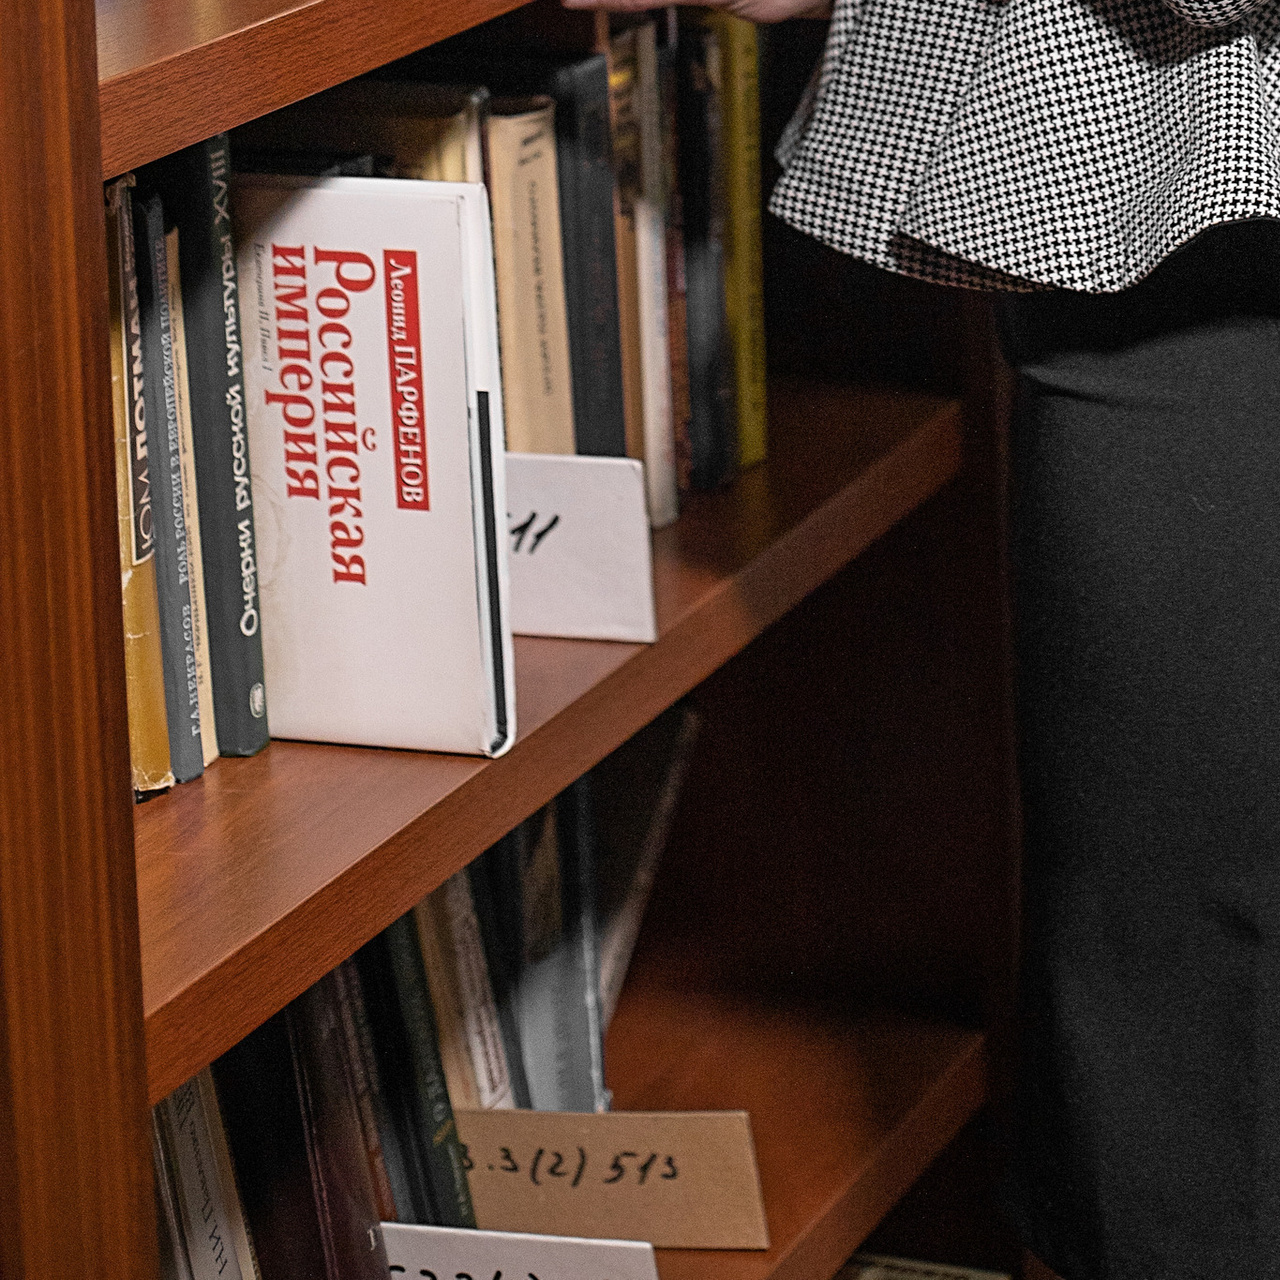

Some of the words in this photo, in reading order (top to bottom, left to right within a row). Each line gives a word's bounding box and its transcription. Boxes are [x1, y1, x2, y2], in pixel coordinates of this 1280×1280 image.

[211, 148, 229, 225] XVIII
[219, 234, 242, 376] культуры
[389, 257, 412, 340] Леонид
[161, 332, 179, 451] ЕВРОПЕЙСКОЙ
[264, 243, 320, 500] империя
[314, 245, 376, 586] Российская
[394, 344, 425, 504] ПАРФЕНОВ
[170, 454, 180, 468] В
[171, 472, 185, 538] РОССИИ
[227, 384, 250, 510] русской
[175, 540, 189, 584] РОЛЬ
[232, 518, 260, 637] Очерки
